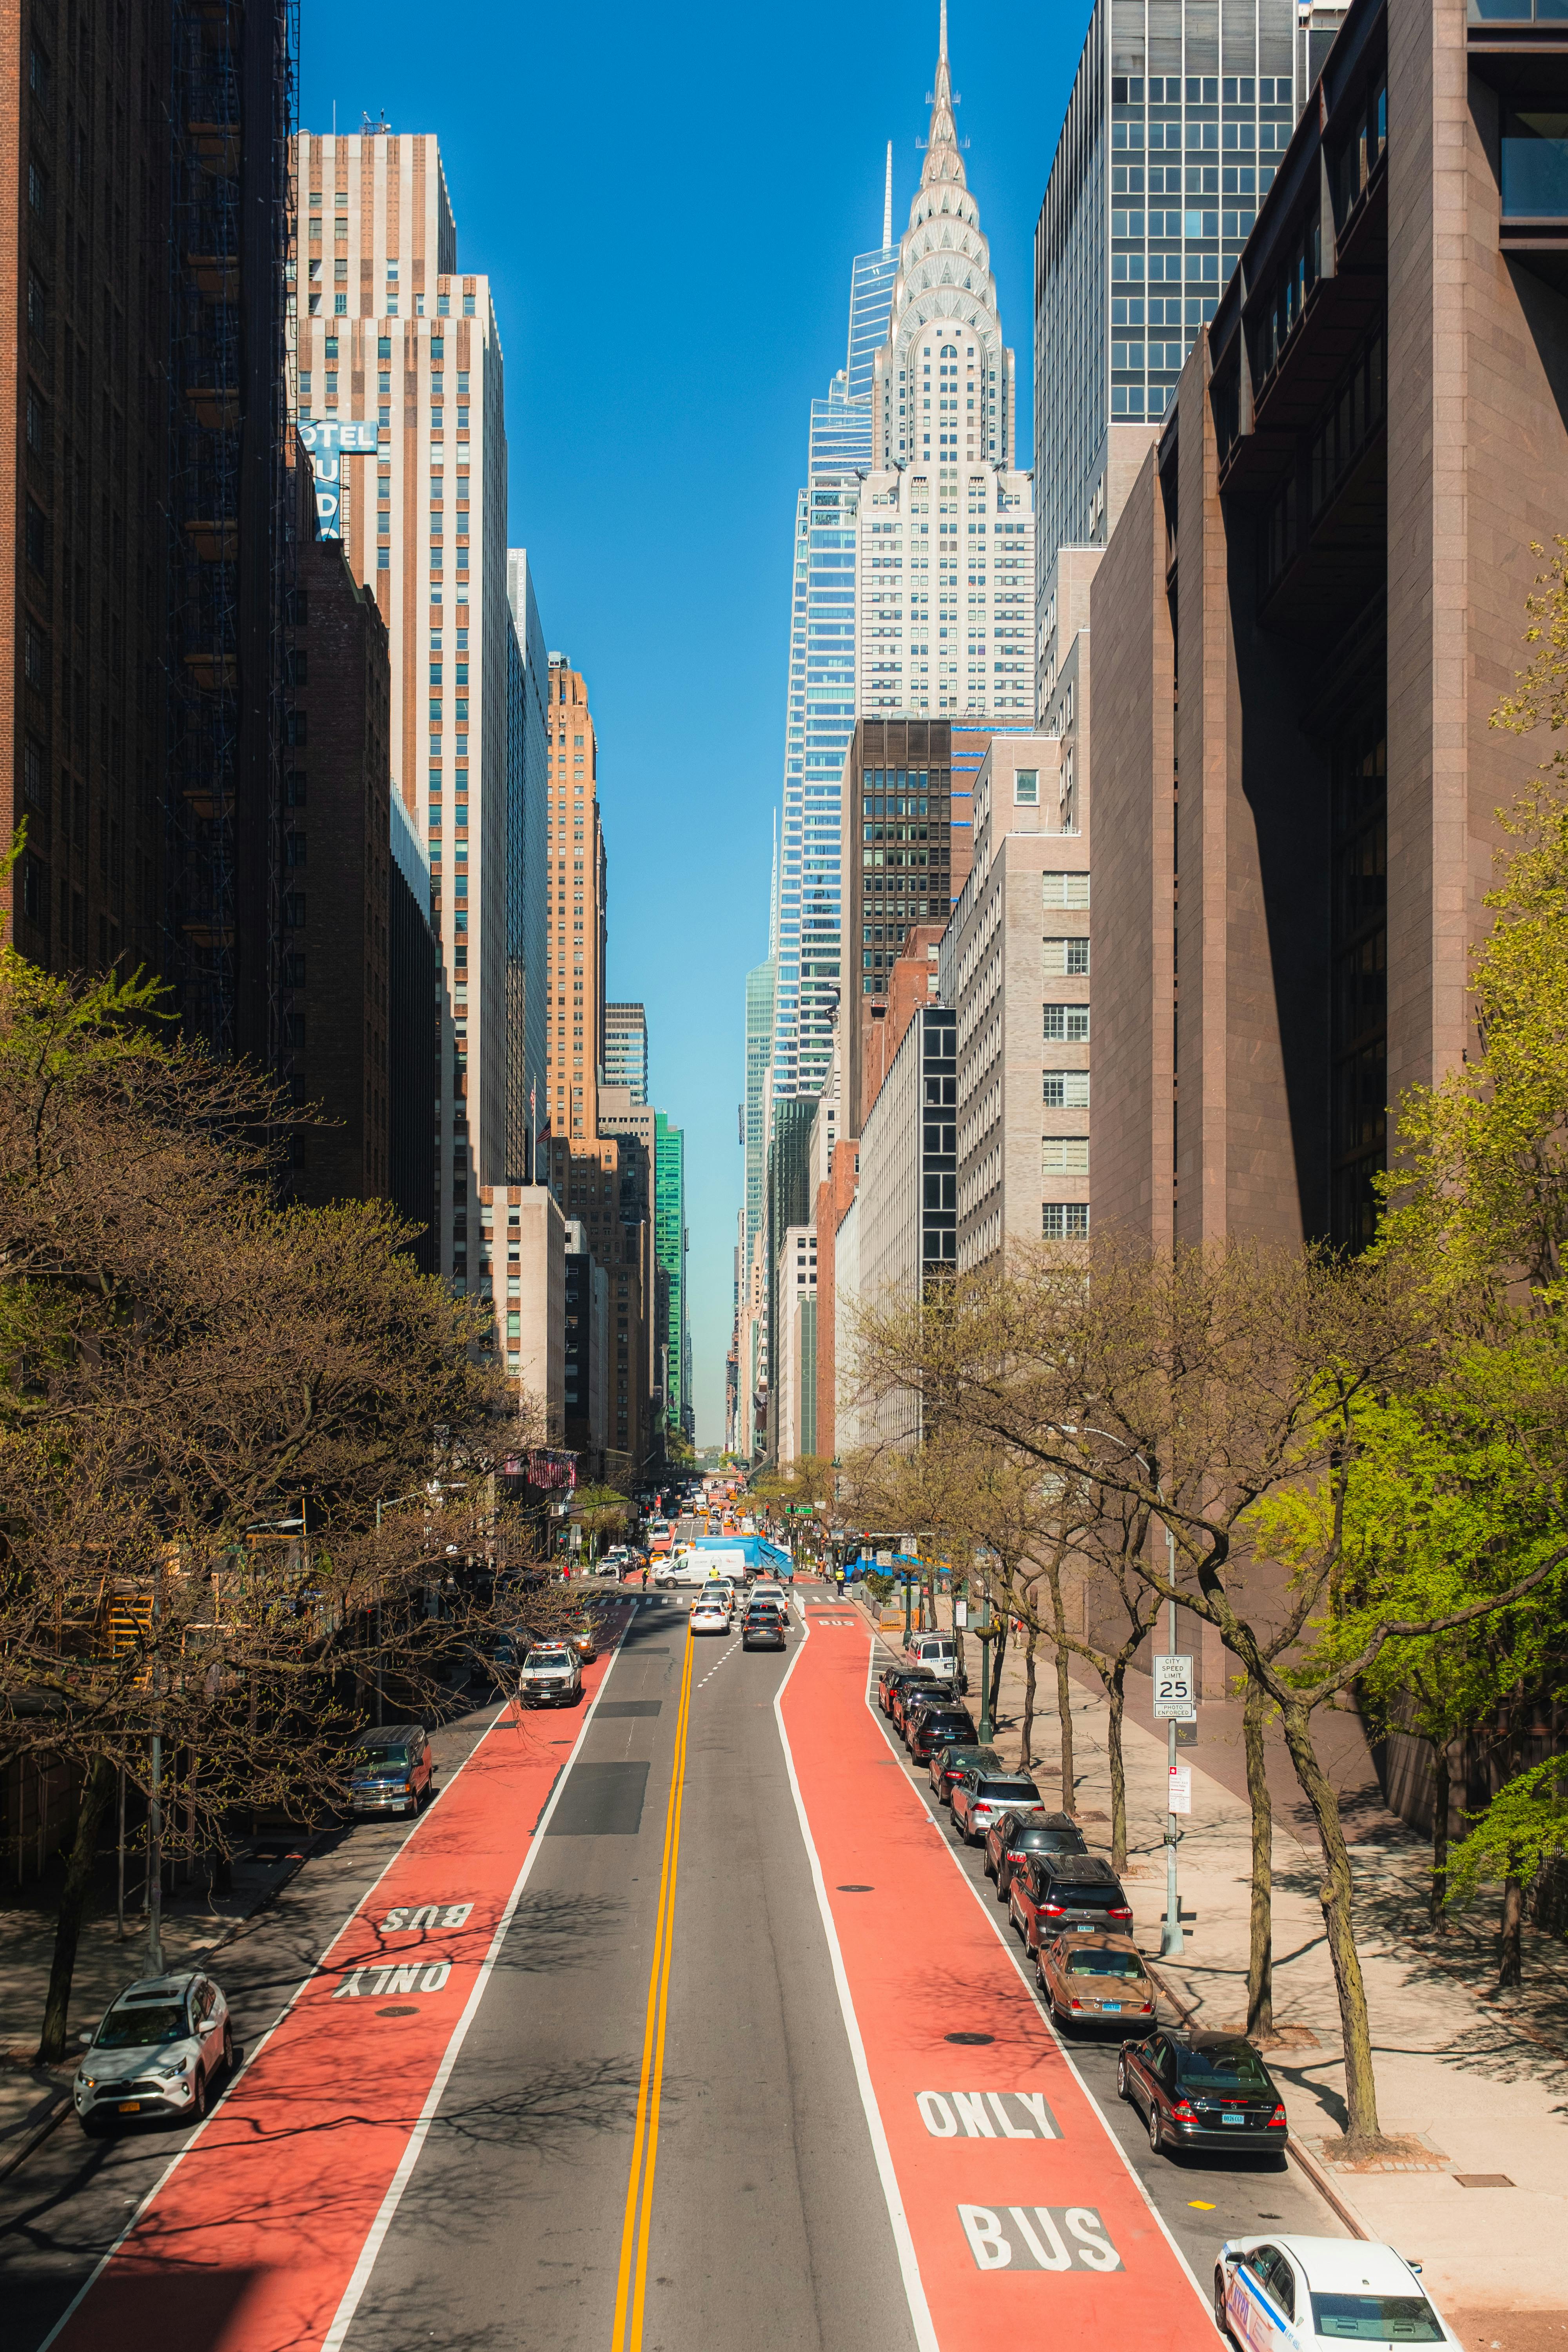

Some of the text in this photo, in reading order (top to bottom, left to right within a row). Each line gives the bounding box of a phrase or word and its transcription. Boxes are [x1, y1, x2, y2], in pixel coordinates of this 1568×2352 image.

[1160, 1681, 1187, 1697] 25
[379, 1903, 475, 1933] BUS
[331, 1962, 452, 1998] ONLY
[916, 2091, 1056, 2139] ONLY
[957, 2204, 1121, 2272] BUS
[1233, 2286, 1249, 2325] NYPD
